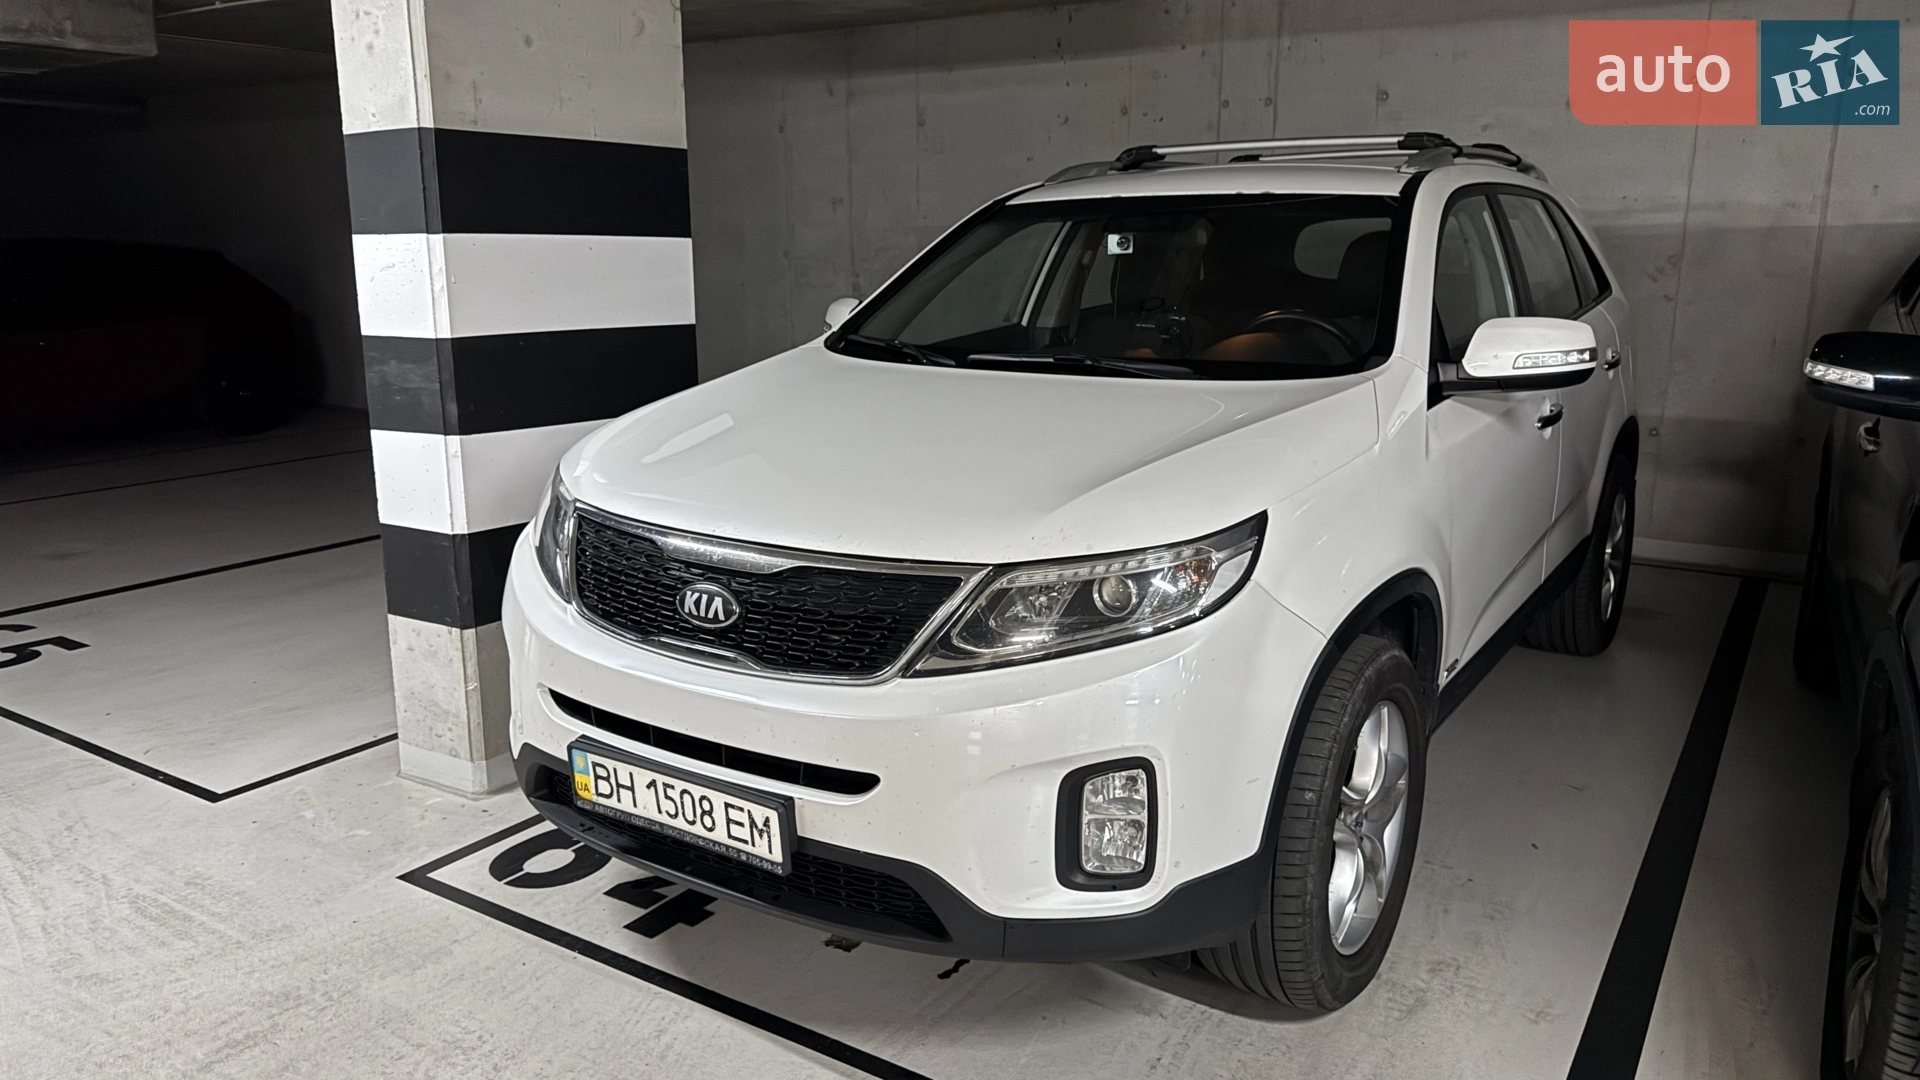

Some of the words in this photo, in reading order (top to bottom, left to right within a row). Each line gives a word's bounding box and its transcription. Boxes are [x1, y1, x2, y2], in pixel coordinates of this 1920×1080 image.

[684, 590, 725, 621] KIA
[576, 780, 591, 795] UA
[590, 760, 638, 809] BH
[645, 778, 716, 833] 1508
[723, 801, 773, 855] EM
